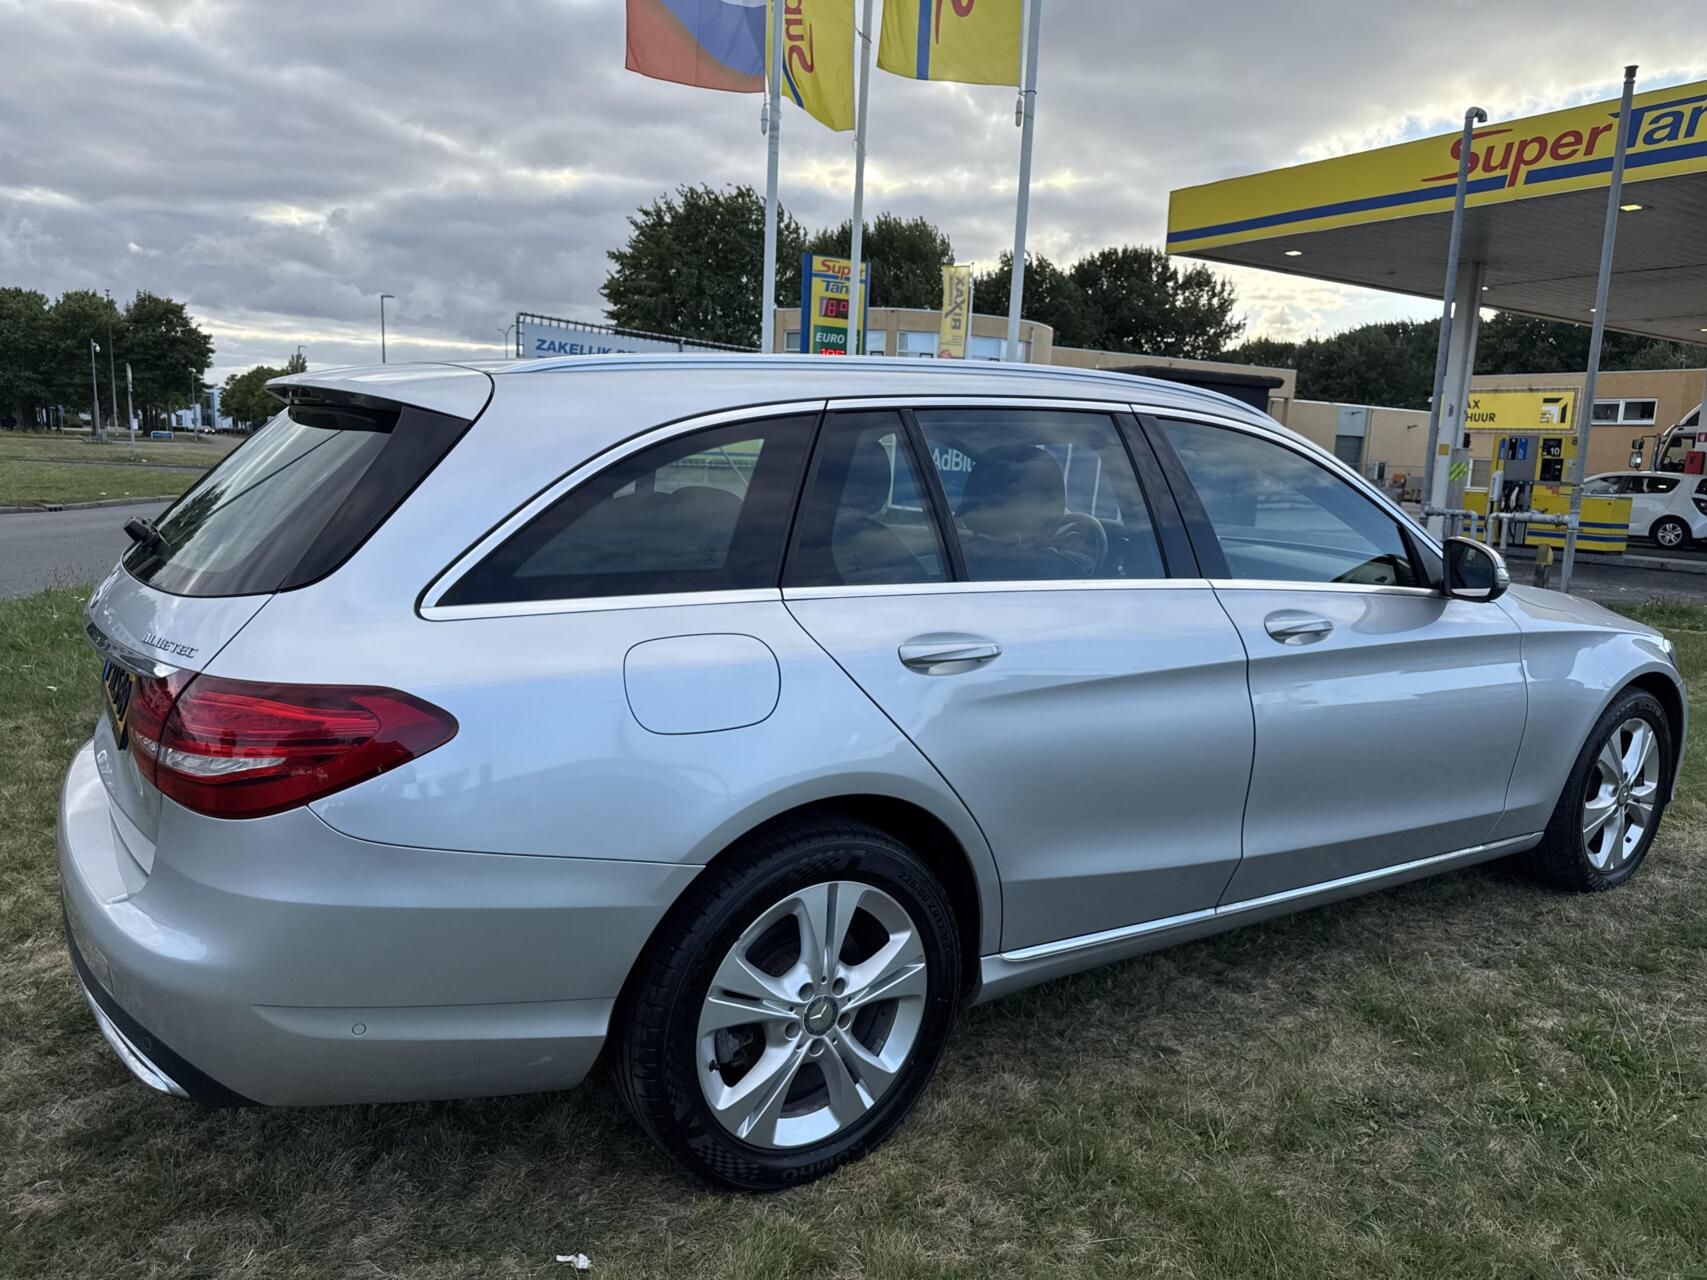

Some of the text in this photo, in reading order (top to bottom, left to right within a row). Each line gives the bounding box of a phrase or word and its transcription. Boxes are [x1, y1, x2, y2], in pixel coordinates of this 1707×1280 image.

[814, 259, 865, 280] Supr
[815, 332, 845, 345] EURO
[1550, 447, 1560, 455] 10
